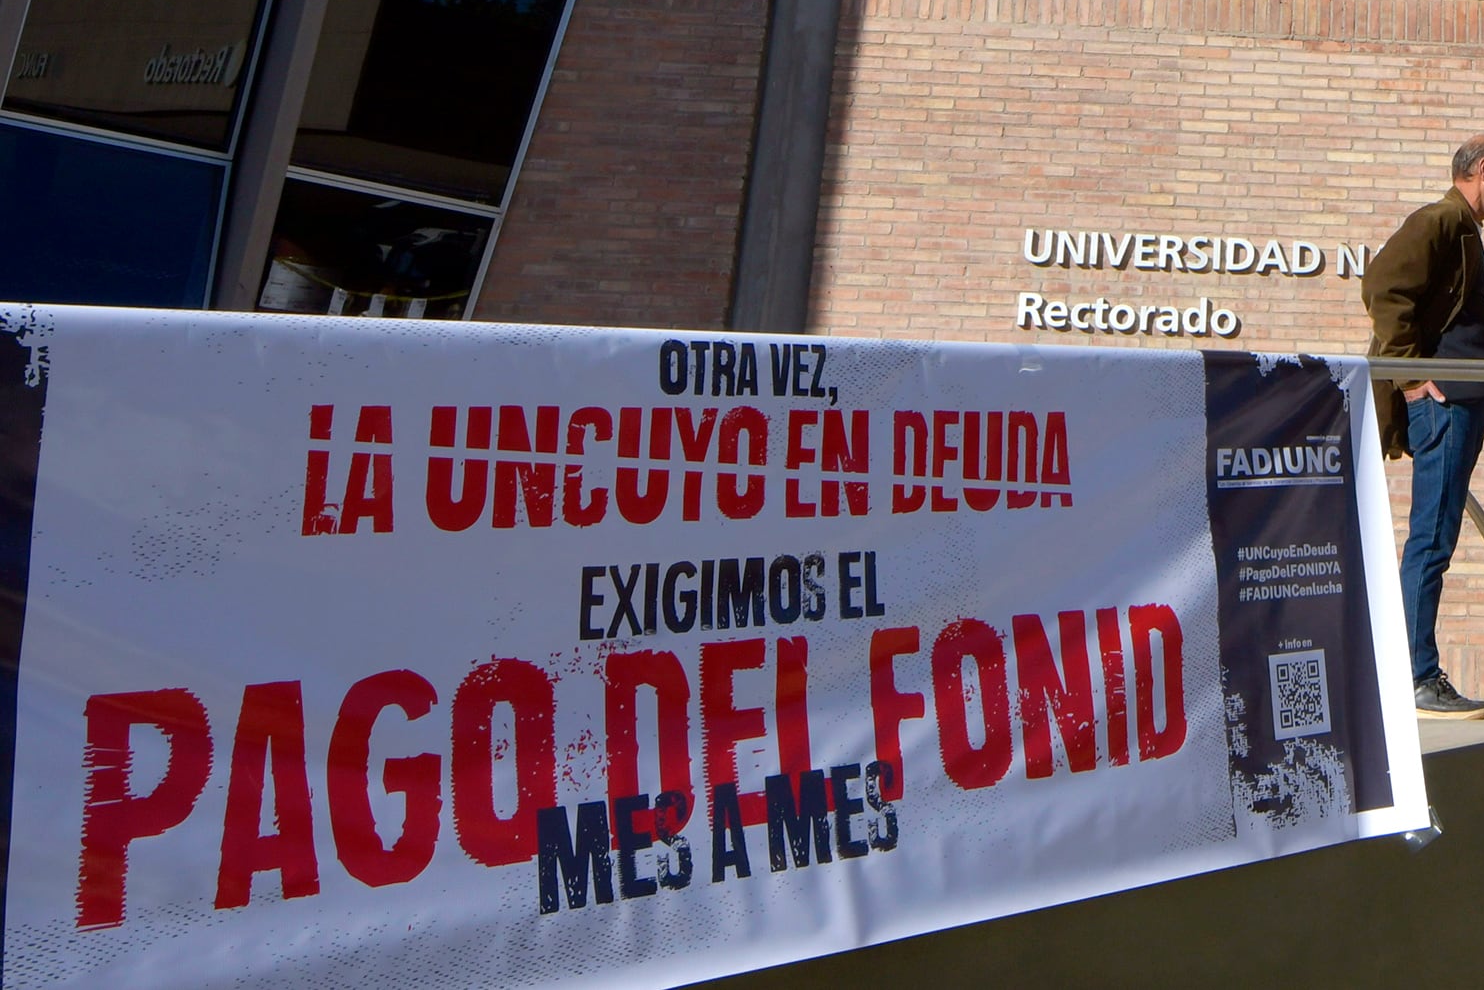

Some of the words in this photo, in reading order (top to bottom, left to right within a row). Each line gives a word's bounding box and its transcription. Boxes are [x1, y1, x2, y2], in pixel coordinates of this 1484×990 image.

[1023, 228, 1322, 276] UNIVERSIDAD
[1016, 291, 1238, 337] Rectorado
[659, 338, 759, 397] OTRA
[769, 343, 839, 407] VEZ,
[302, 403, 395, 537] LA
[425, 404, 770, 532] UNCUYO
[783, 408, 871, 519] EN
[891, 409, 1075, 515] DEUDA
[1216, 445, 1343, 477] FADIUNC
[1237, 542, 1338, 561] #UNCuyoEnDeuda
[1238, 561, 1342, 582] #PagoDelFONIDYA
[579, 550, 826, 641] EXIGIMOS
[838, 551, 885, 620] EL
[1238, 580, 1343, 602] #FADIUNCenlucha
[1284, 638, 1301, 650] info
[1301, 639, 1313, 648] en
[74, 650, 557, 933] PAGO
[868, 602, 1188, 804] FONID
[535, 790, 694, 916] MES
[711, 781, 752, 883] A
[764, 759, 900, 873] MES
